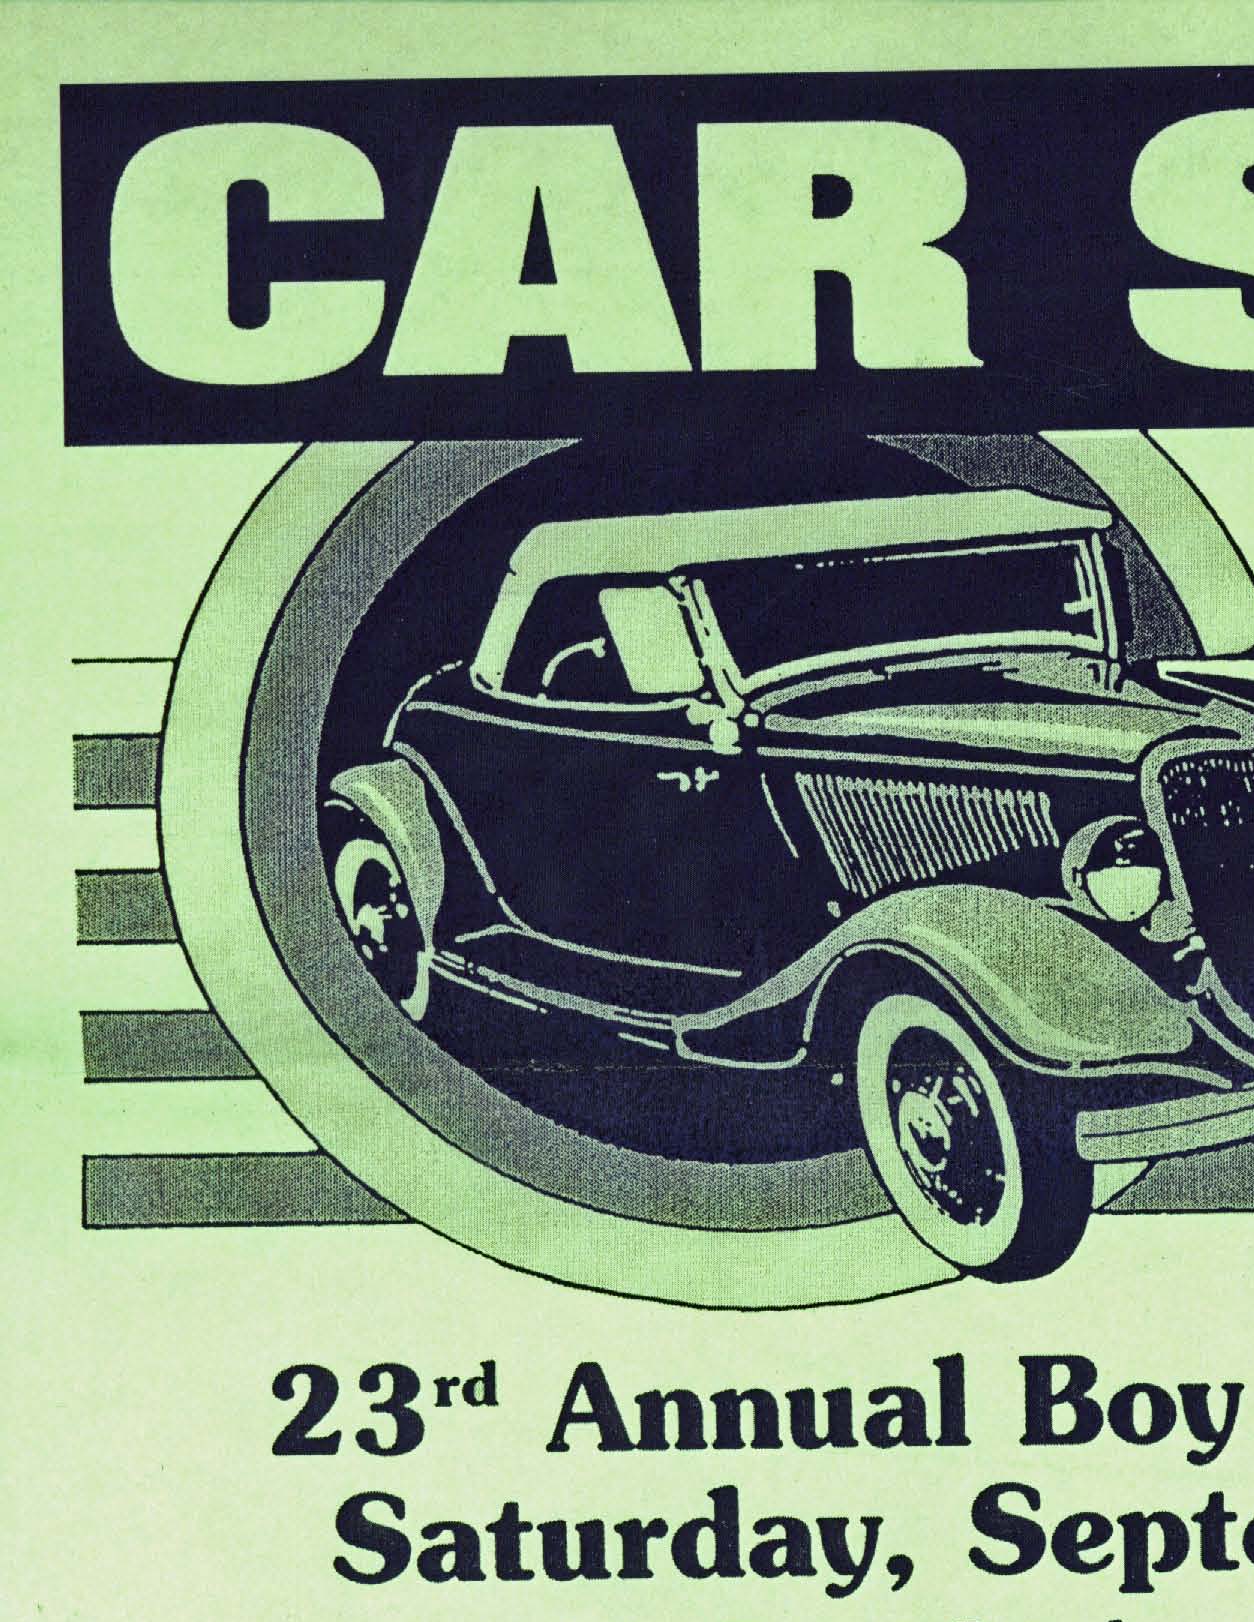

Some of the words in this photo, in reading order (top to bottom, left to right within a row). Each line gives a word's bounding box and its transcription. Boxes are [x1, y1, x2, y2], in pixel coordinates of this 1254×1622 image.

[110, 120, 984, 385] CAR
[270, 1358, 500, 1458] 23rd
[544, 1351, 973, 1454] Annual
[1017, 1353, 1246, 1468] Boy
[331, 1483, 916, 1600] Saturday,
